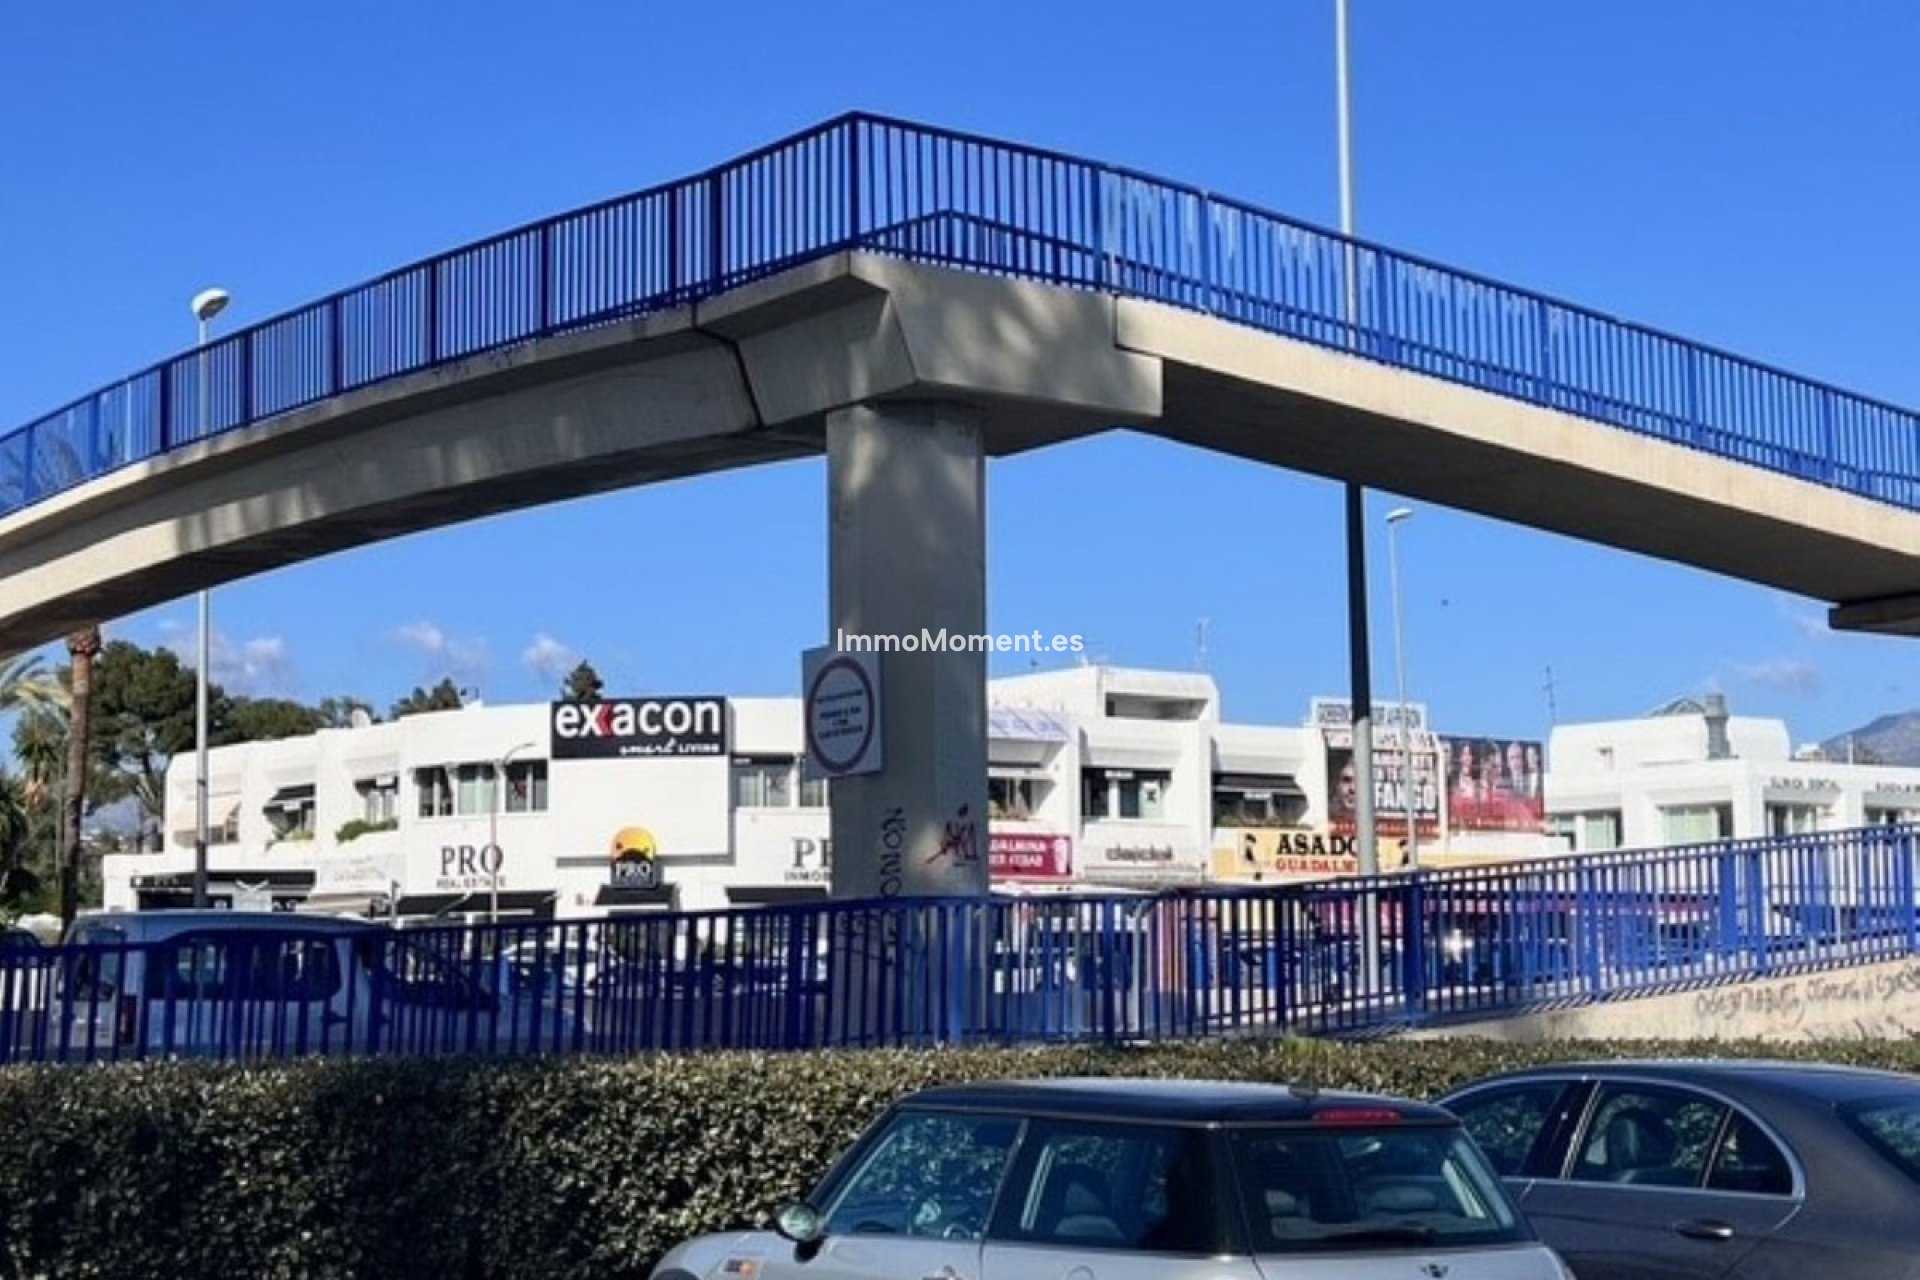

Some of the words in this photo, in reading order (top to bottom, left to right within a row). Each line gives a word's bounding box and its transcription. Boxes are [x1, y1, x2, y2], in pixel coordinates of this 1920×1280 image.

[556, 701, 720, 737] exacon
[441, 844, 504, 876] PRO
[615, 861, 652, 879] PRO
